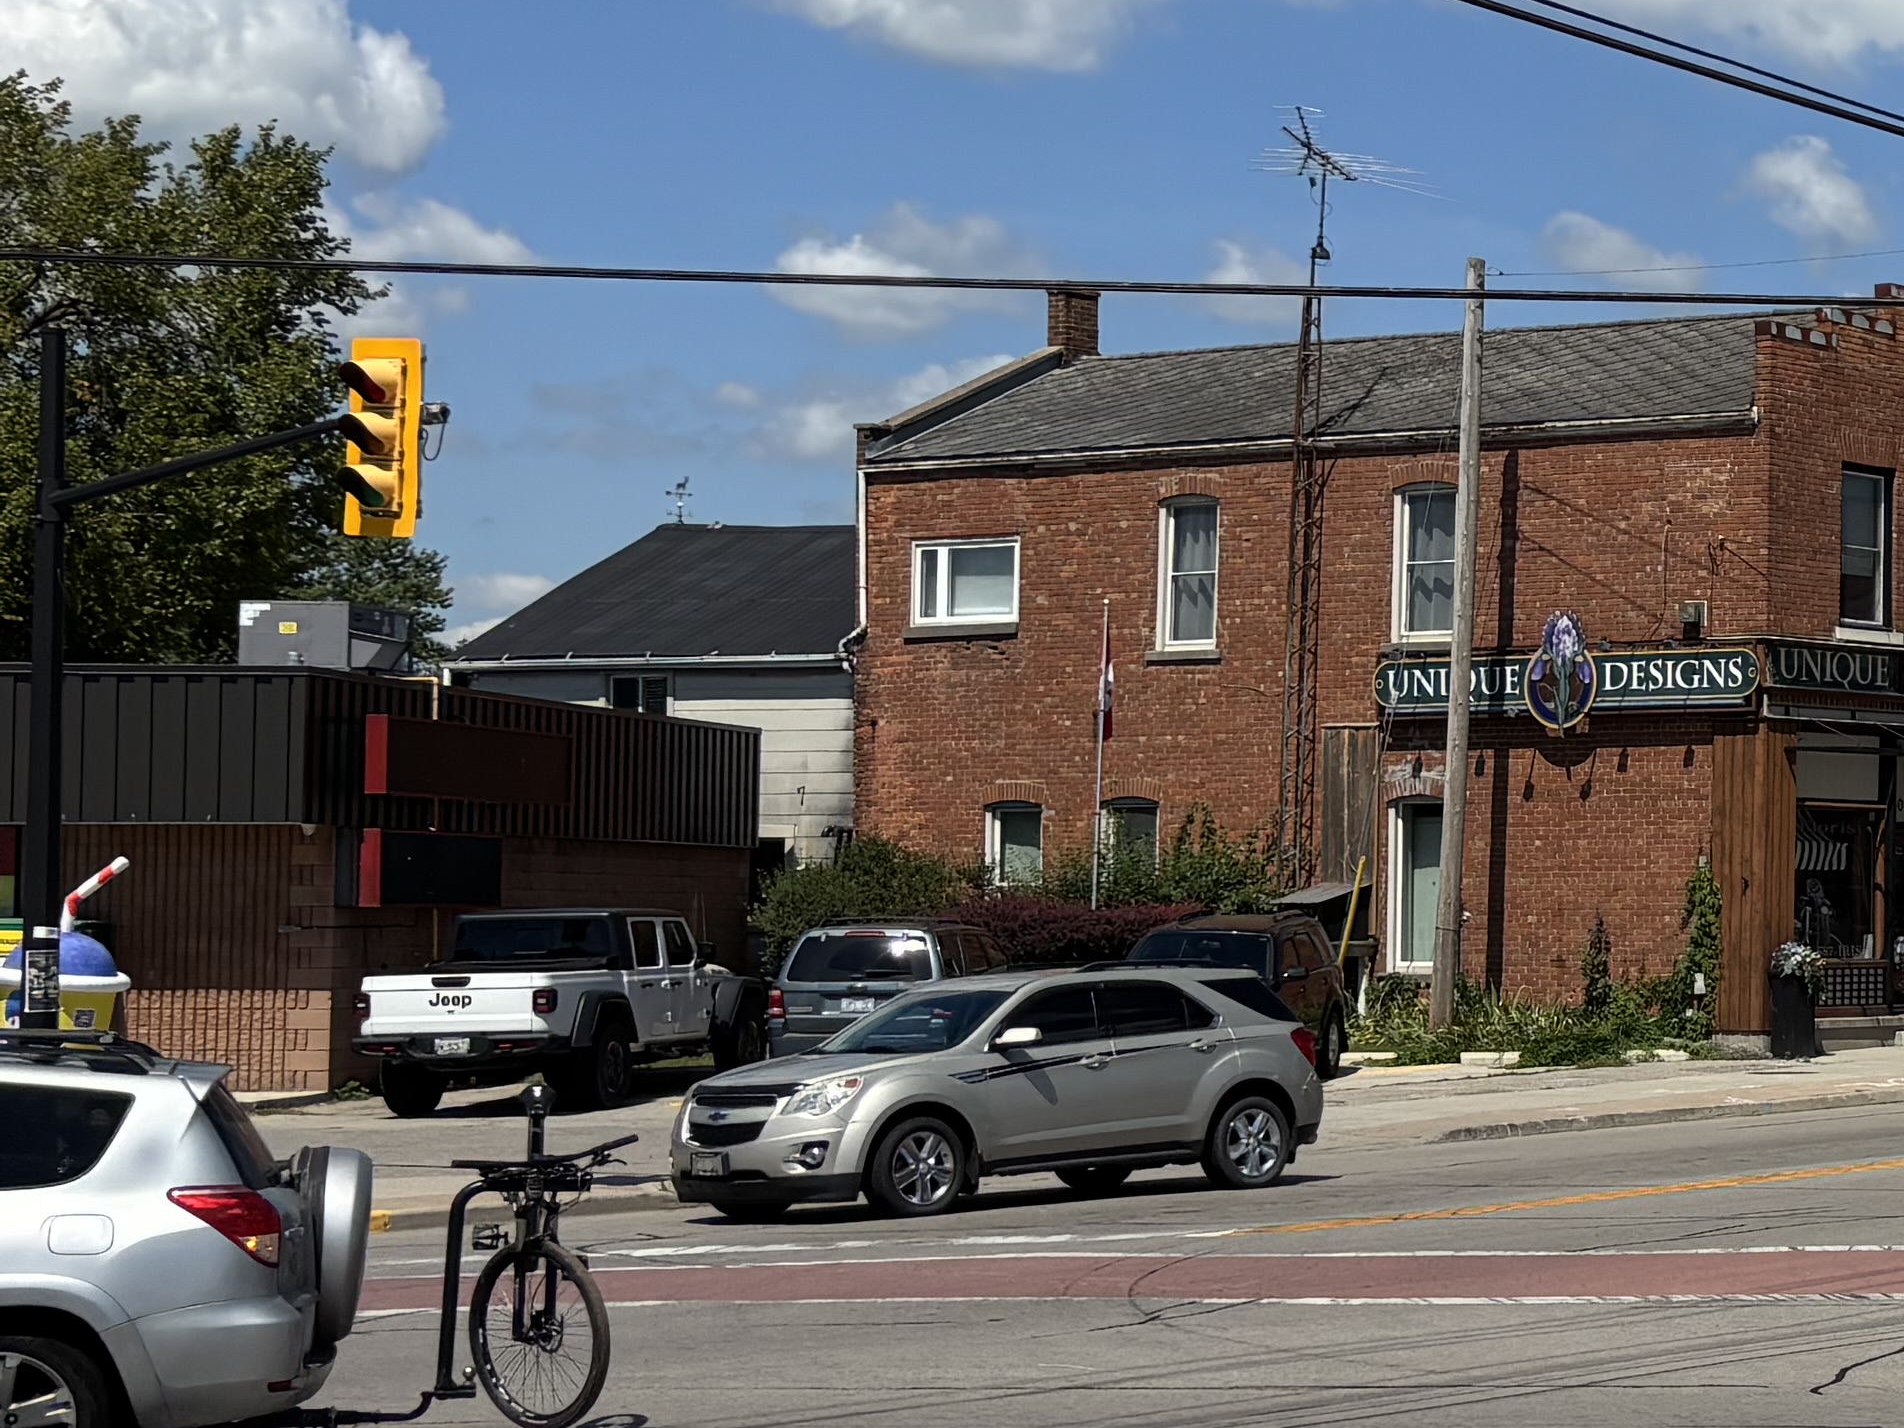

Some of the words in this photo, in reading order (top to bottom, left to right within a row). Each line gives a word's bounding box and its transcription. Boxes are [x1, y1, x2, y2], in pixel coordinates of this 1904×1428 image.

[1387, 664, 1520, 703] UNIUE
[1602, 656, 1743, 692] DESIGNS
[1778, 646, 1890, 690] UNIQUE
